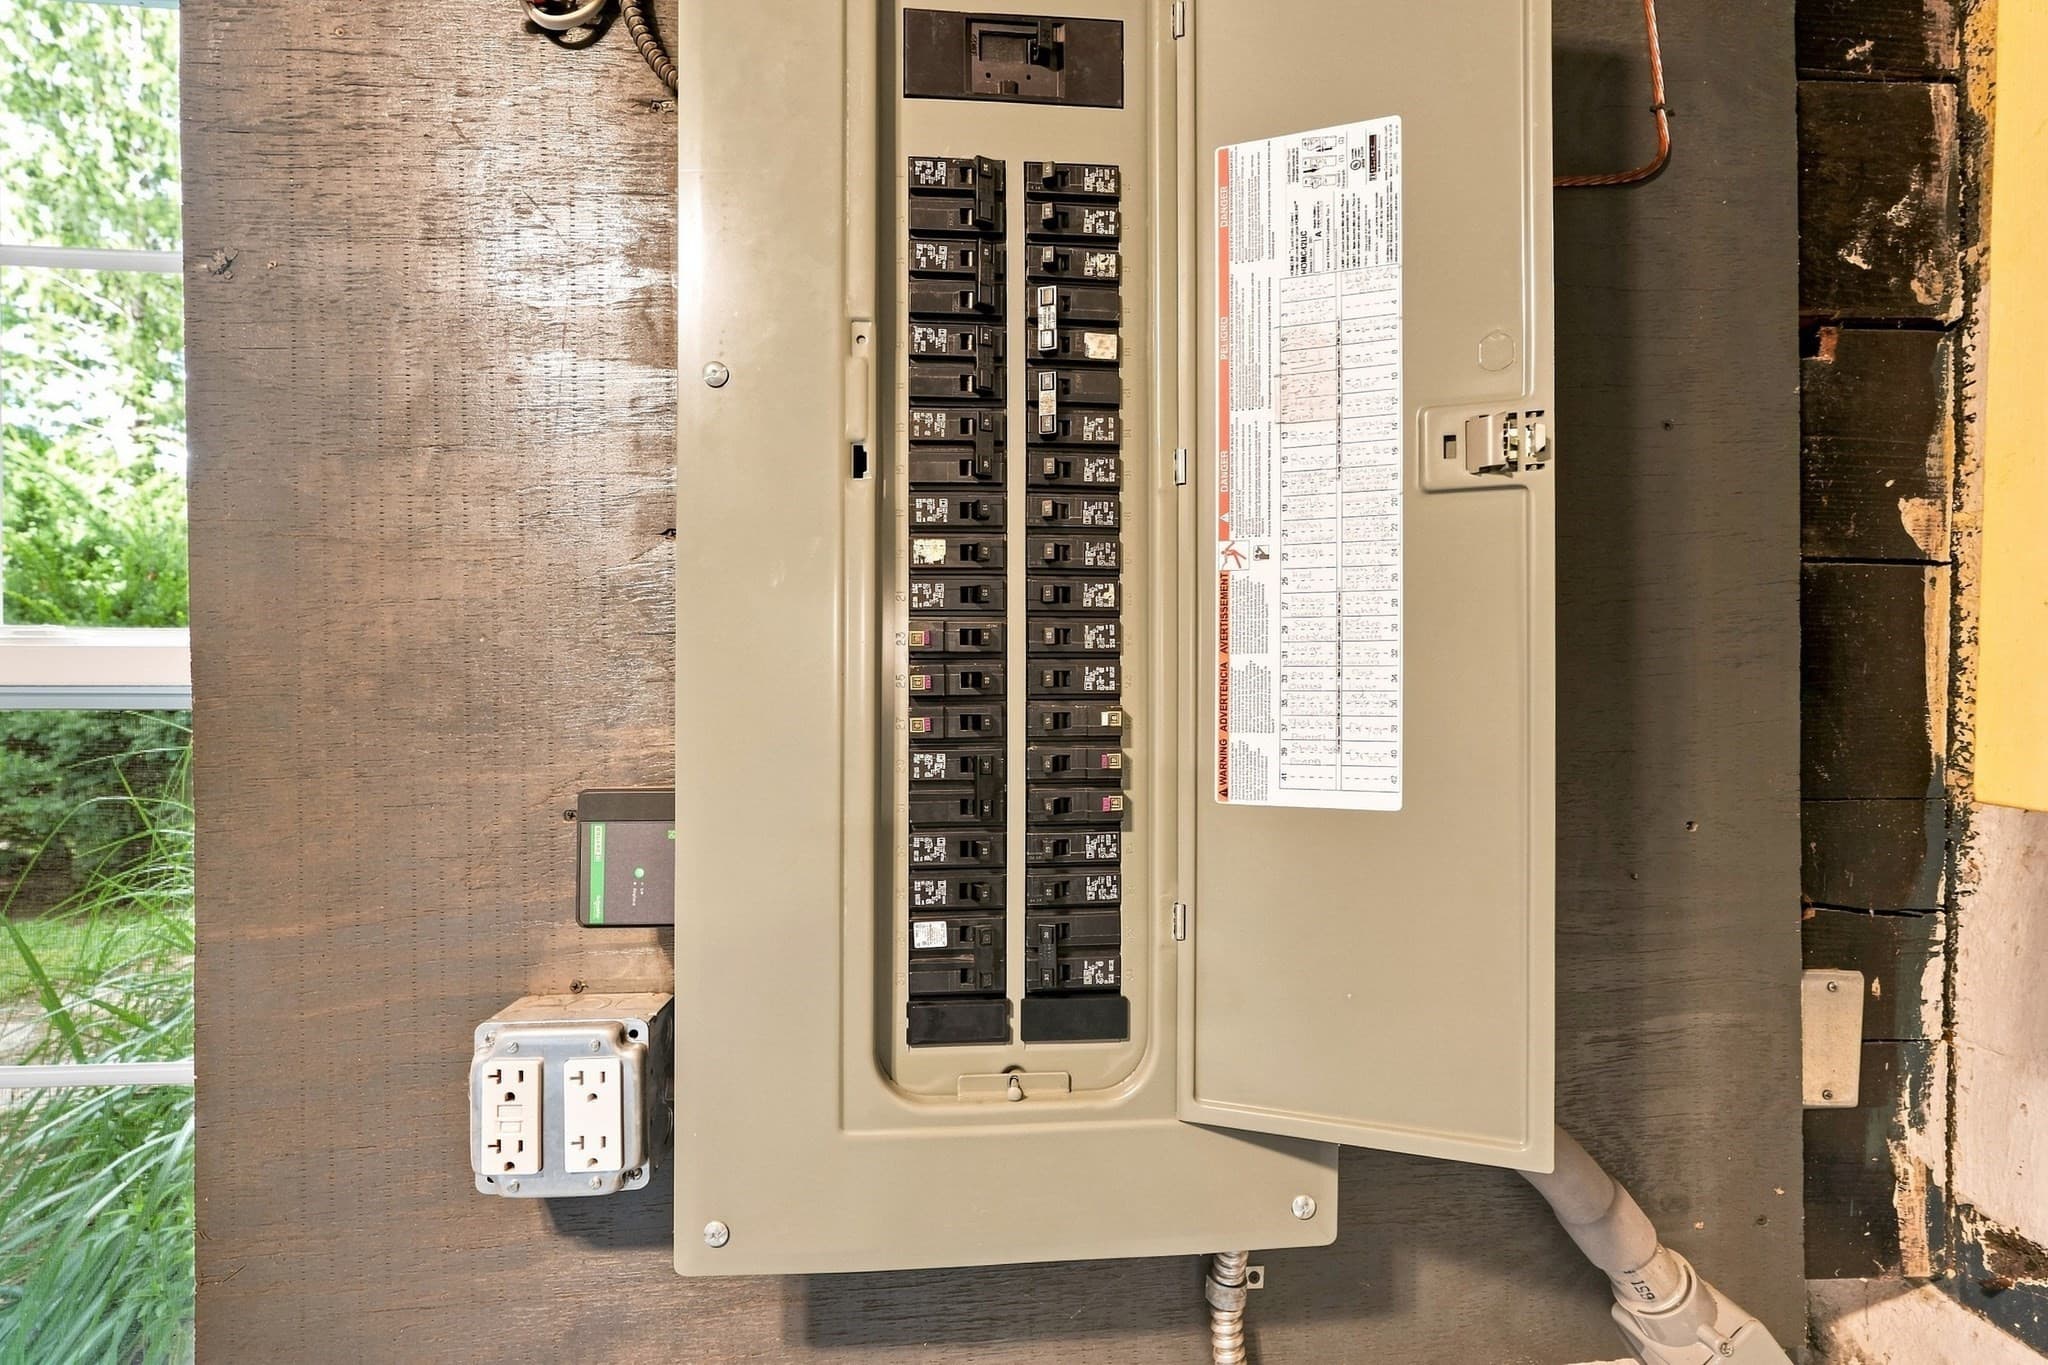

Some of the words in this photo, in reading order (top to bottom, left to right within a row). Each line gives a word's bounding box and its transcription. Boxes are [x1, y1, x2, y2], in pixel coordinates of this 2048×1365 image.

[1220, 185, 1228, 228] DANGER
[1220, 316, 1228, 360] PELIGRO
[1220, 450, 1228, 493] DANGER
[1219, 572, 1229, 654] AVERTISSEMENT
[896, 631, 905, 646] 23
[896, 674, 905, 688] 25
[1219, 662, 1228, 732] ADVERTENCIA
[1219, 739, 1227, 785] WARNING
